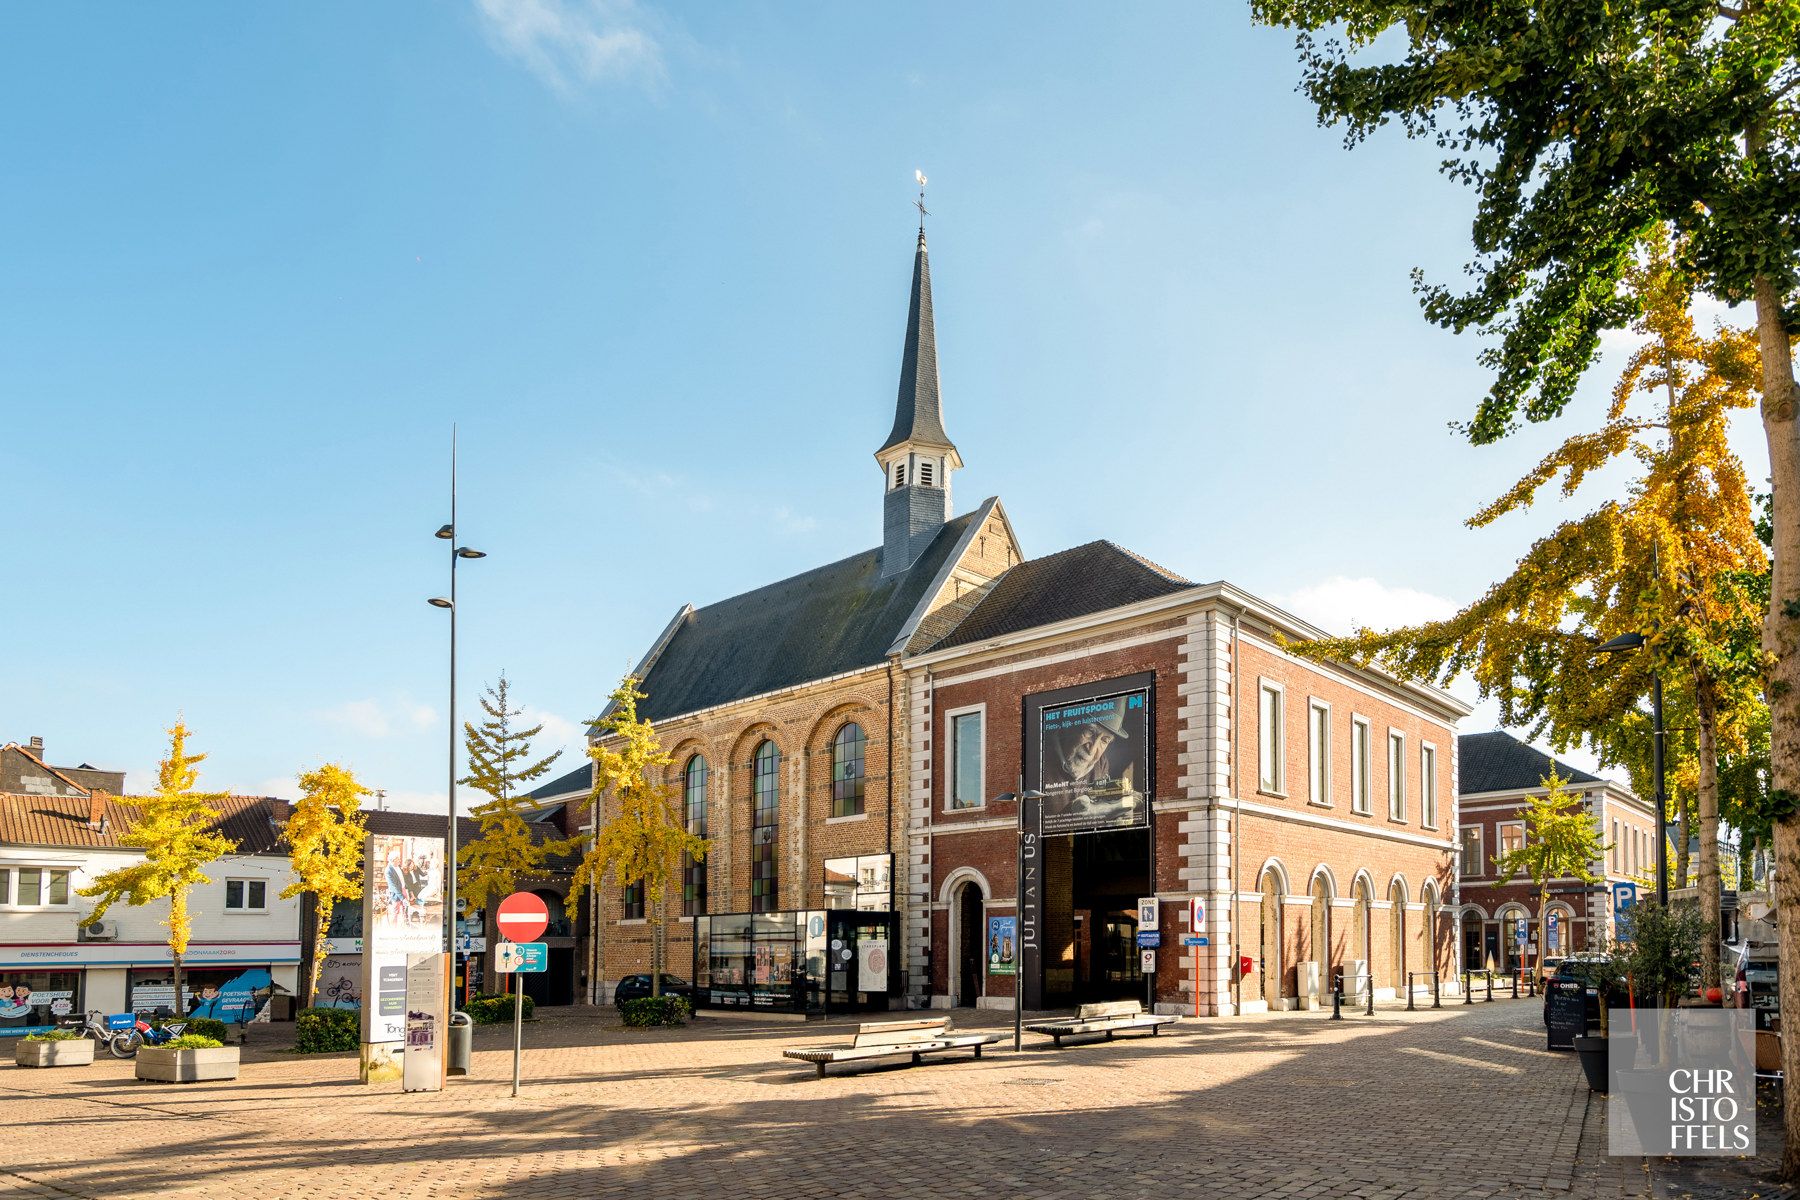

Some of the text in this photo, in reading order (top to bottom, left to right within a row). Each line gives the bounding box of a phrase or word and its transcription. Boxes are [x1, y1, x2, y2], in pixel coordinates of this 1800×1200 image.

[1045, 702, 1115, 721] HET FRUITSPOOR
[1024, 833, 1038, 950] JULIANUS
[1615, 887, 1632, 909] P
[1518, 919, 1525, 928] P
[1549, 917, 1556, 926] P
